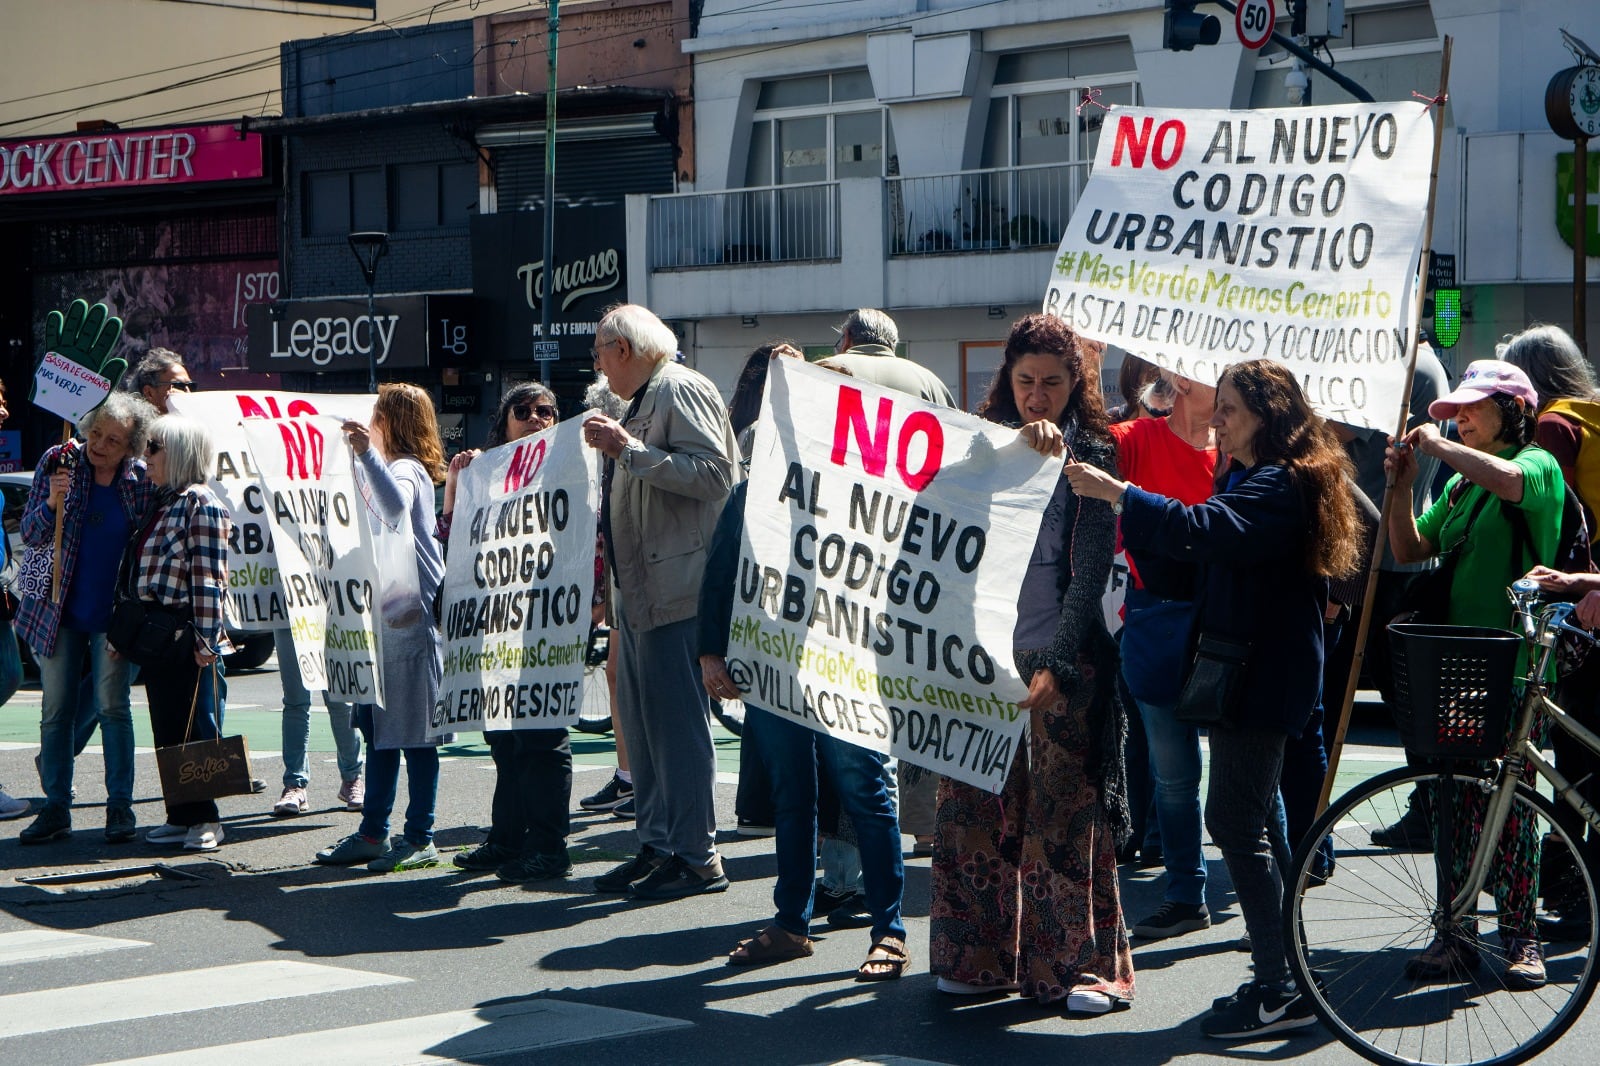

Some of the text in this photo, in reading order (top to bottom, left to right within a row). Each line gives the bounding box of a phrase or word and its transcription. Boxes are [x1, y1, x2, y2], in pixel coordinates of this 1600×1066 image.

[1244, 4, 1267, 32] 50
[1586, 69, 1596, 83] 12
[1110, 115, 1187, 170] NO
[1201, 120, 1257, 165] AL
[1588, 120, 1595, 133] 6
[62, 133, 197, 185] CENTER
[1172, 170, 1346, 218] CODIGO
[1085, 208, 1374, 272] URBANISTICO
[517, 248, 620, 312] Tomasso
[1437, 278, 1453, 287] 1200
[270, 315, 400, 366] Legacy
[441, 319, 468, 354] Lg
[562, 322, 568, 335] Y
[1047, 287, 1126, 338] BASTA
[1131, 304, 1166, 342] DE
[1166, 308, 1255, 354] RUIDOS
[1281, 324, 1409, 364] OCUPACION
[37, 366, 87, 396] MAS VERDE
[70, 366, 82, 377] DE
[831, 384, 944, 492] NO
[504, 438, 546, 494] NO
[470, 488, 569, 547] AL NUEVO
[778, 461, 986, 574] AL NUEVO
[474, 541, 554, 589] CODIGO
[794, 525, 940, 615] CODIGO
[447, 583, 581, 642] URBANISTICO
[740, 556, 996, 685] URBANISTICO
[730, 615, 1021, 723] #MasVerdeMenosCemento
[504, 681, 579, 719] RESISTE
